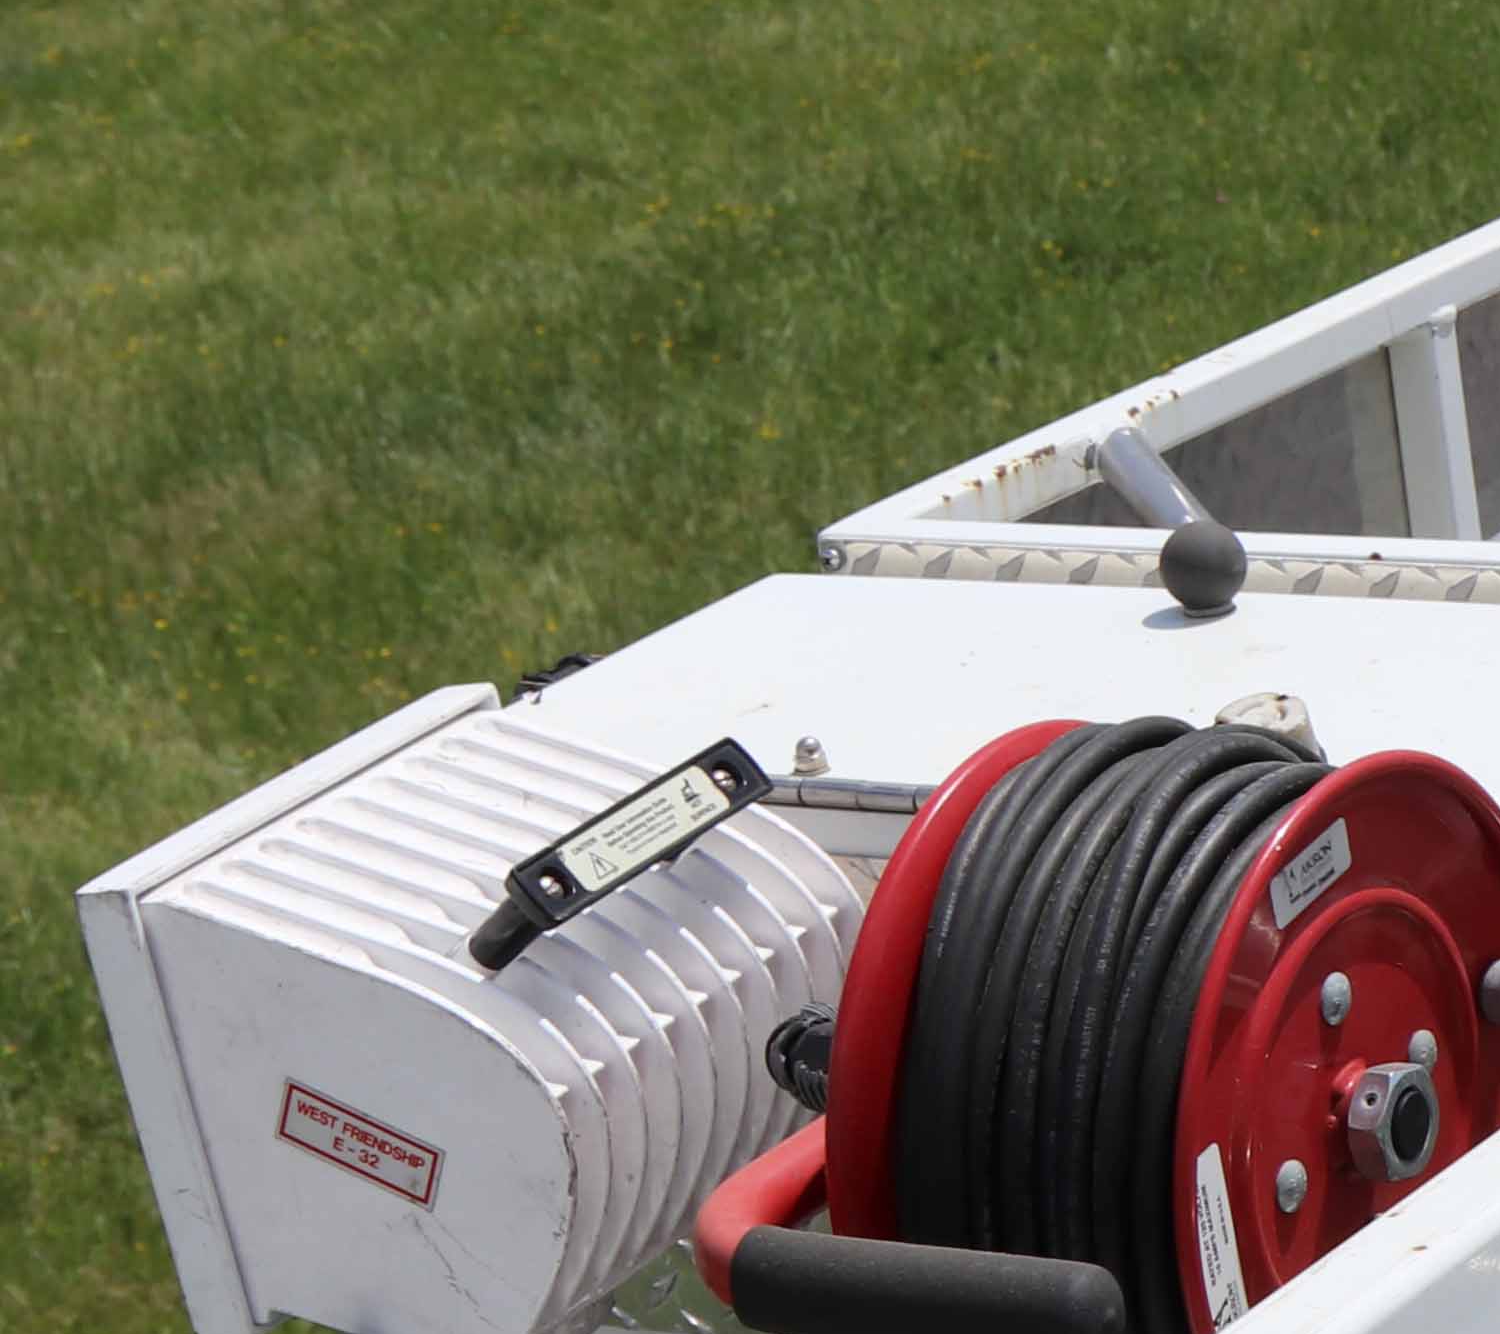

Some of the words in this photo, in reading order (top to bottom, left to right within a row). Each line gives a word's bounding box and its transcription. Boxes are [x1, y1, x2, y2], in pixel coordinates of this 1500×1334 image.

[297, 1099, 338, 1129] WEST
[342, 1122, 425, 1169] FRIENDSHIP
[333, 1136, 345, 1152] E
[358, 1149, 380, 1169] 32
